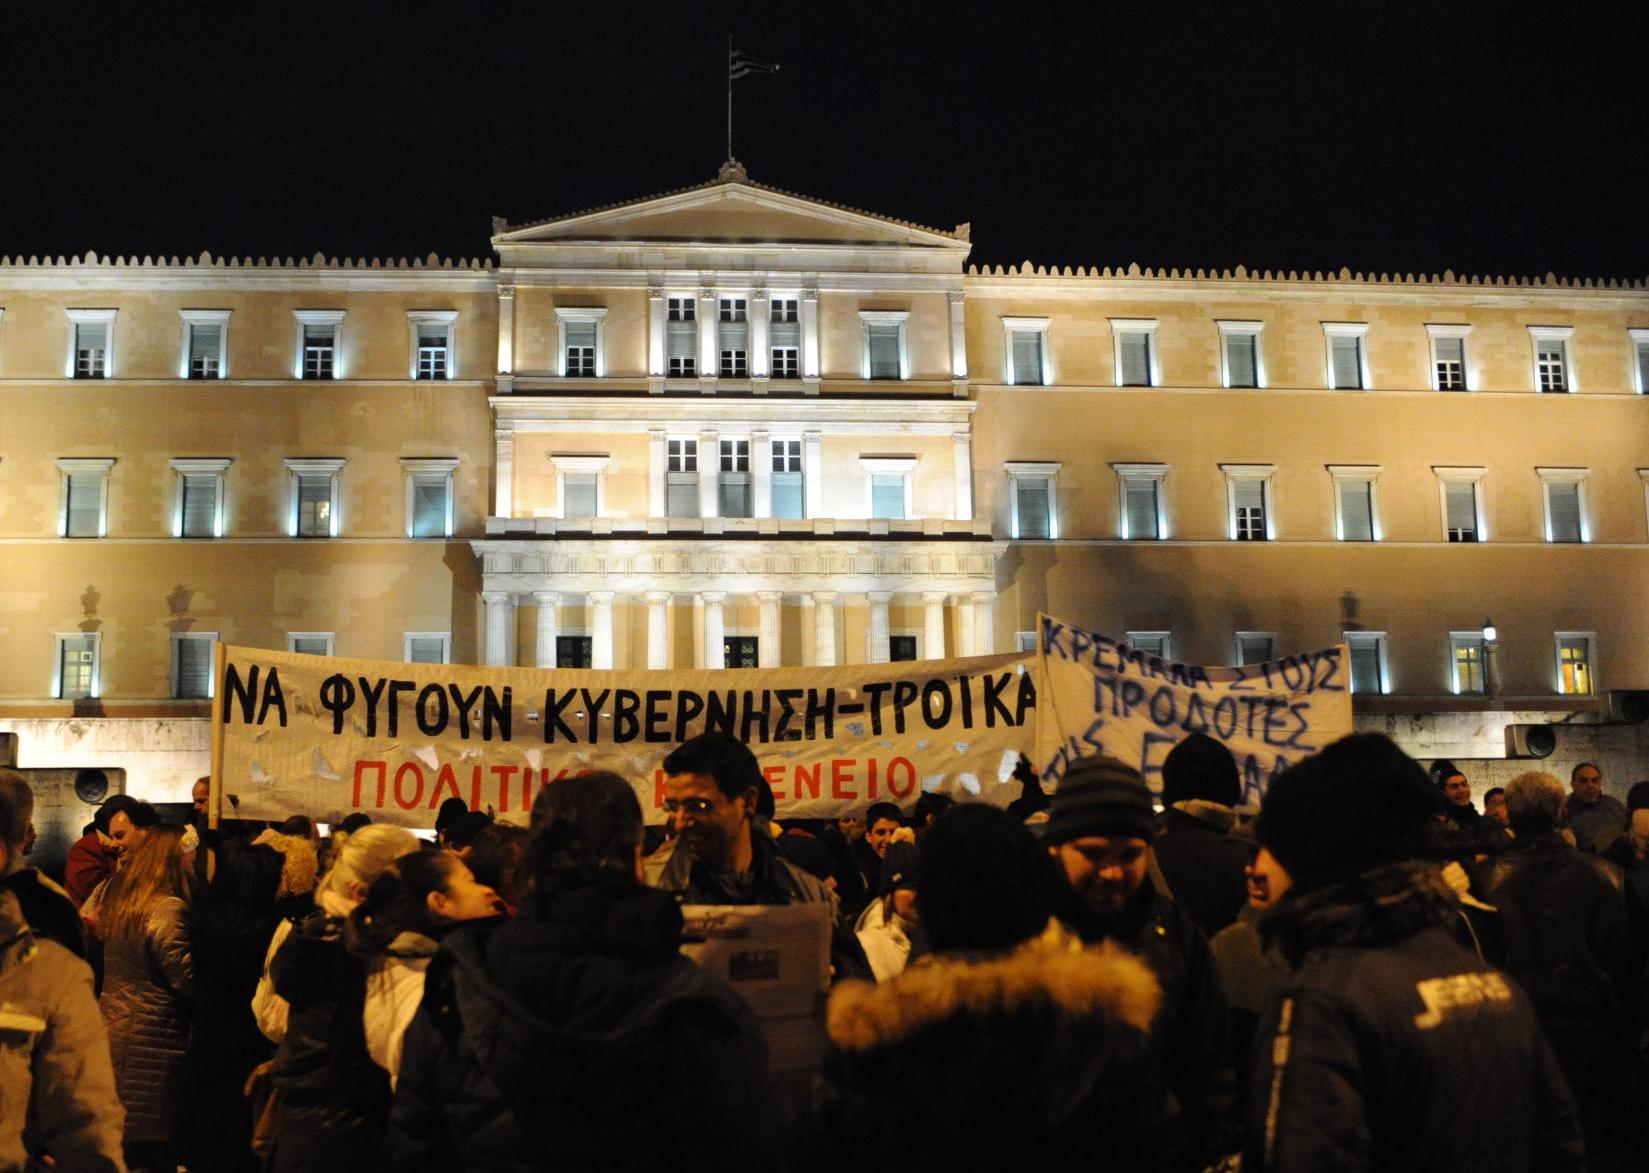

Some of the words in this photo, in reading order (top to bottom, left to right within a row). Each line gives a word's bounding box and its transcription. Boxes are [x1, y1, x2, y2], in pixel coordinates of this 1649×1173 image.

[223, 663, 287, 727] ΝΑ
[319, 673, 512, 742] ΦΥΓΟΥΝ
[1094, 676, 1316, 751] ΠΡΟΔΟΤΕΣ
[352, 760, 595, 812] ΠΟΛΙΤΙ
[654, 756, 916, 808] ΕΝΕΙΟ
